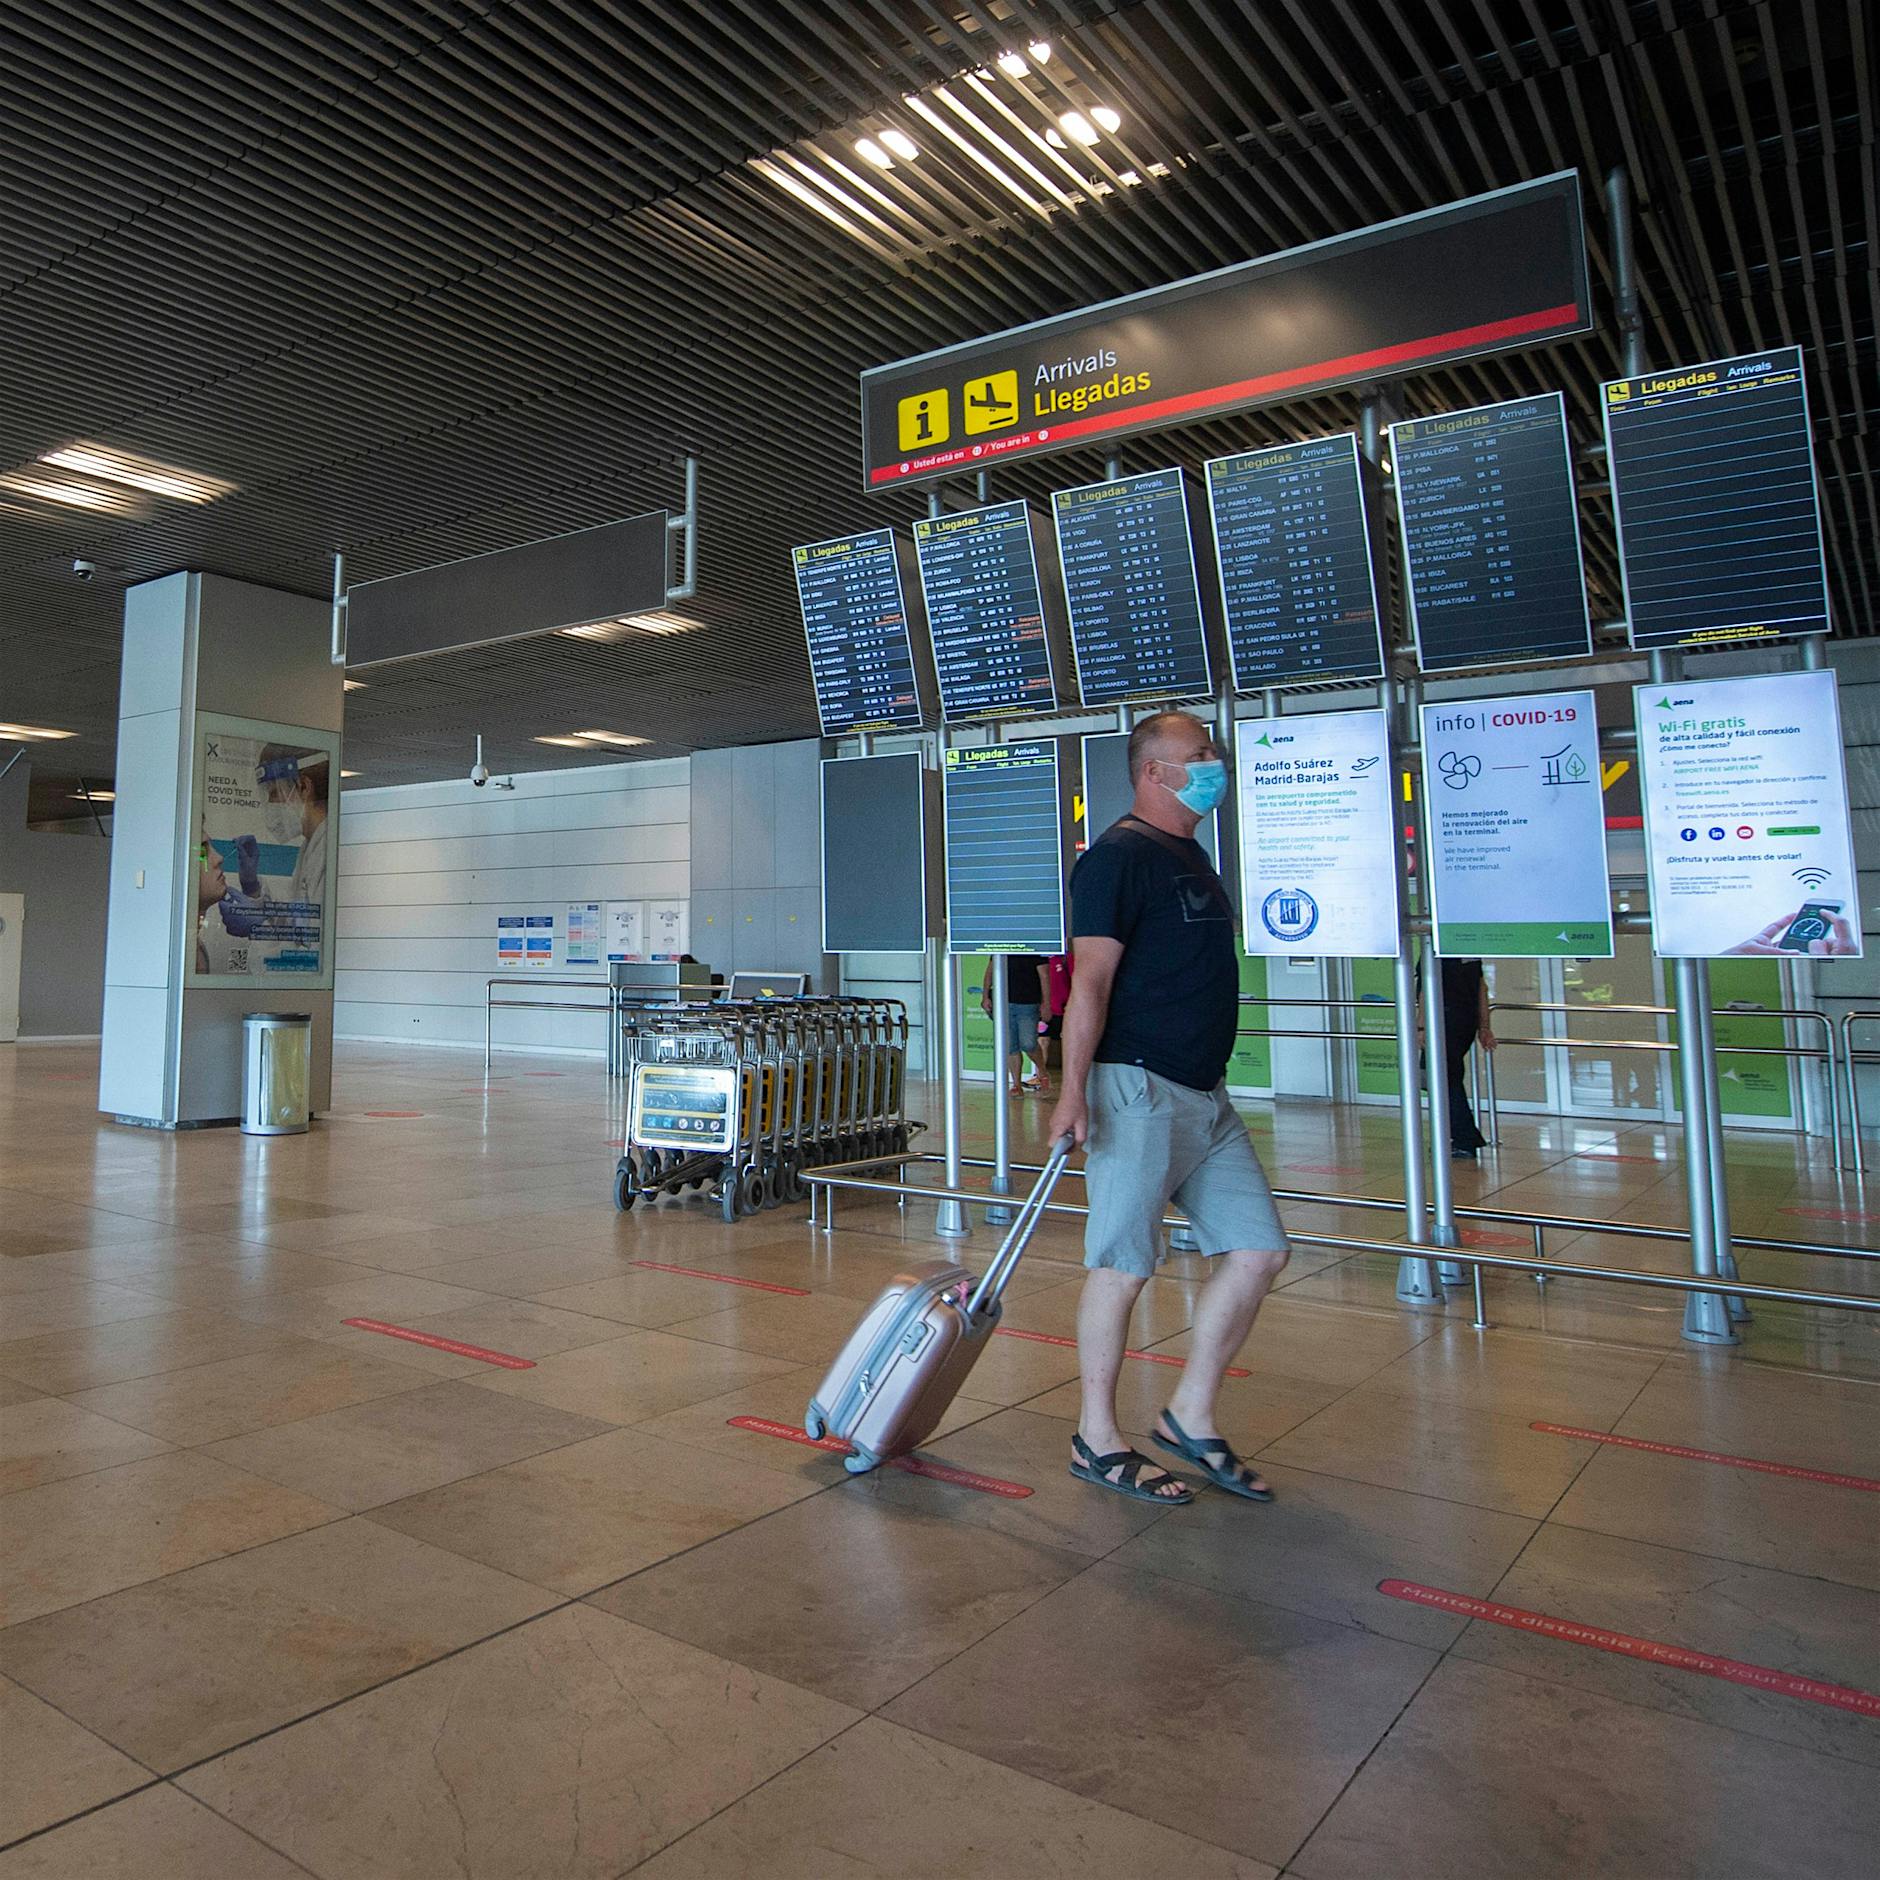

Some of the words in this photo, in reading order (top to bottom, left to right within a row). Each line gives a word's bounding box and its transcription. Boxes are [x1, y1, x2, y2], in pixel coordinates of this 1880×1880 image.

[1034, 350, 1117, 386] Arrivals
[1640, 368, 1716, 394] Llegadas
[1727, 360, 1772, 377] Arrivals
[1034, 372, 1151, 416] Llegadas
[1424, 412, 1489, 434] Llegadas
[1498, 405, 1536, 420] Arrivals
[914, 457, 935, 469] Usted
[936, 453, 953, 464] está
[954, 451, 964, 460] en
[990, 441, 1006, 451] You
[1006, 438, 1021, 447] are
[1022, 435, 1030, 444] in
[1235, 451, 1292, 470] Llegadas
[1300, 445, 1333, 458] Arrivals
[1078, 484, 1126, 502] Llegadas
[1133, 478, 1162, 491] Arrivals
[936, 515, 979, 531] Llegadas
[984, 510, 1009, 521] Arrivals
[812, 542, 850, 557] Llegadas
[1435, 714, 1474, 731] info
[1492, 708, 1576, 726] COVID-19
[1658, 720, 1695, 732] Wi-Fi
[1700, 716, 1745, 731] gratis
[1692, 731, 1724, 739] calidad
[1757, 726, 1800, 735] conexión
[965, 748, 1008, 760] Llegadas
[1014, 746, 1039, 755] Arrivals
[1254, 760, 1290, 771] Adolfo
[1294, 757, 1332, 769] Suárez
[208, 775, 230, 784] NEED
[1255, 772, 1339, 786] Madrid-Barajas
[208, 785, 232, 795] COVID
[234, 788, 252, 797] TEST
[1306, 789, 1356, 799] comprometido
[208, 795, 218, 803] TO
[219, 796, 232, 805] GO
[233, 798, 260, 808] HOME?
[1470, 809, 1508, 818] mejorado
[1476, 845, 1510, 853] improved
[1493, 1608, 1515, 1621] la
[1520, 1616, 1632, 1649] distancia
[1652, 1647, 1715, 1671] Keep
[1723, 1664, 1780, 1686] your
